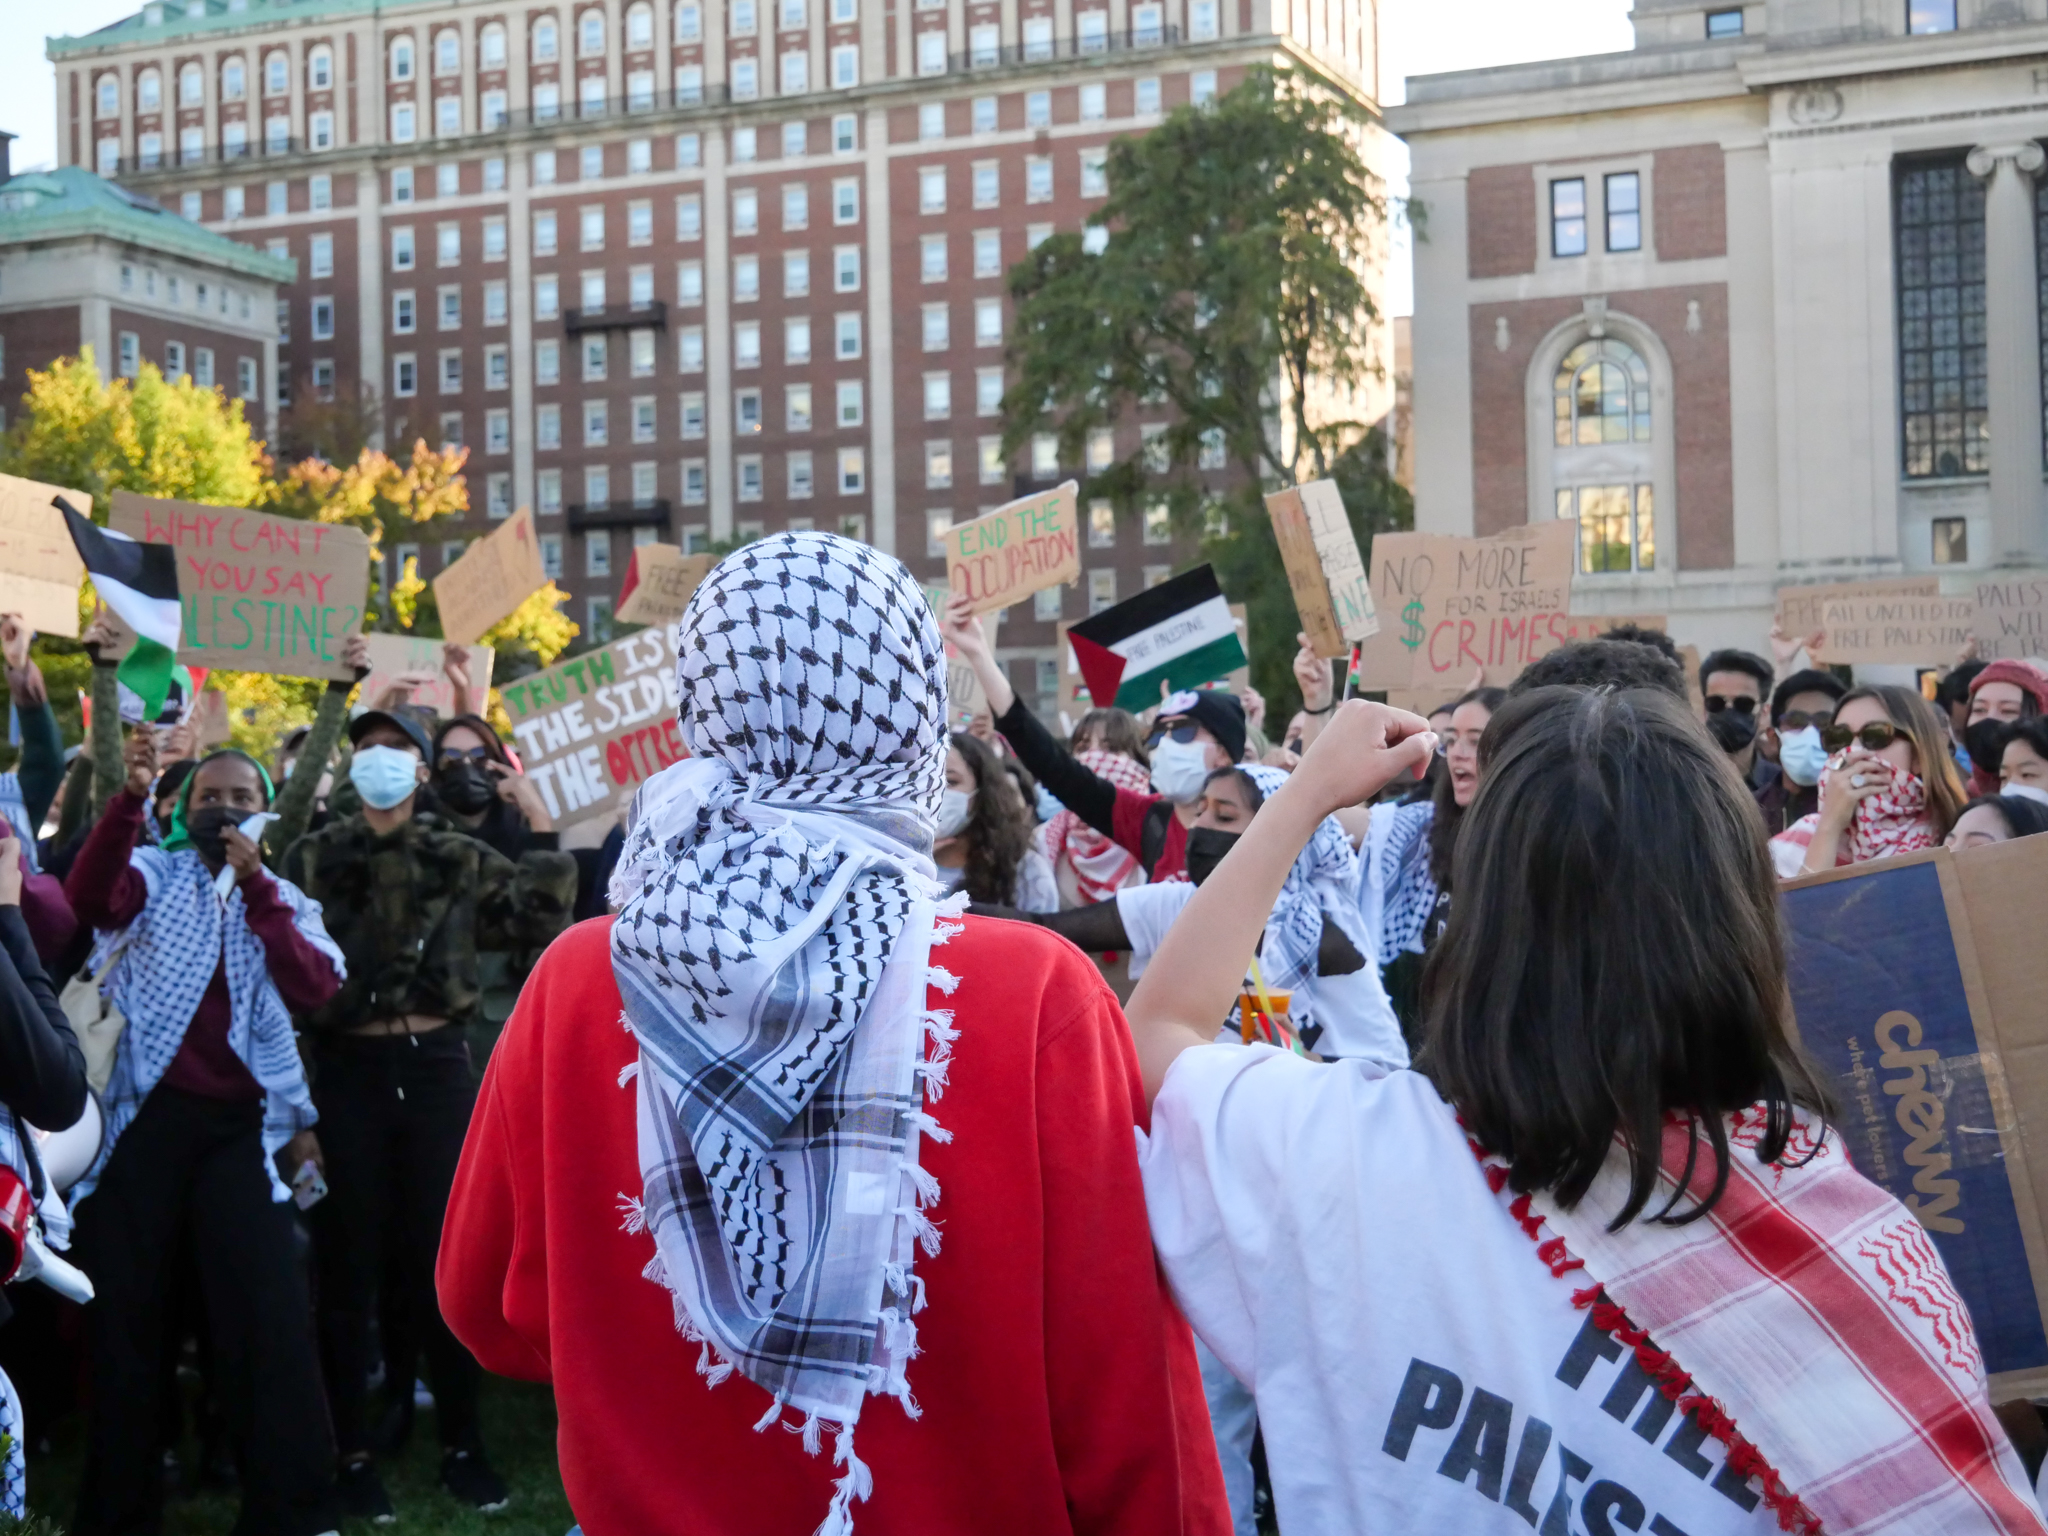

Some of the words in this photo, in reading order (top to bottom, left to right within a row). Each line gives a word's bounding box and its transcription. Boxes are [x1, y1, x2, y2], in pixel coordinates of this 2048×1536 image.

[144, 509, 222, 547] WHY
[959, 527, 1008, 556] END
[1016, 499, 1062, 538] THE
[187, 555, 256, 593] YOU
[262, 566, 332, 604] SAY
[1382, 554, 1434, 598] NO
[1457, 546, 1537, 590] MORE
[1977, 583, 2048, 607] PALES
[1445, 594, 1487, 616] FOR
[1498, 588, 1561, 613] ISRAELS
[1428, 612, 1568, 672] CRIMES
[505, 650, 615, 716] TRUTH
[616, 628, 665, 676] IS
[513, 700, 594, 762] THE
[595, 666, 680, 733] SIDE
[528, 744, 611, 820] THE
[606, 717, 691, 786] OPPRE
[1847, 1036, 1867, 1087] where
[1856, 1094, 1882, 1124] pet
[1874, 1010, 1965, 1235] chewy
[1867, 1126, 1889, 1181] lovers
[1381, 1357, 1690, 1536] PALES
